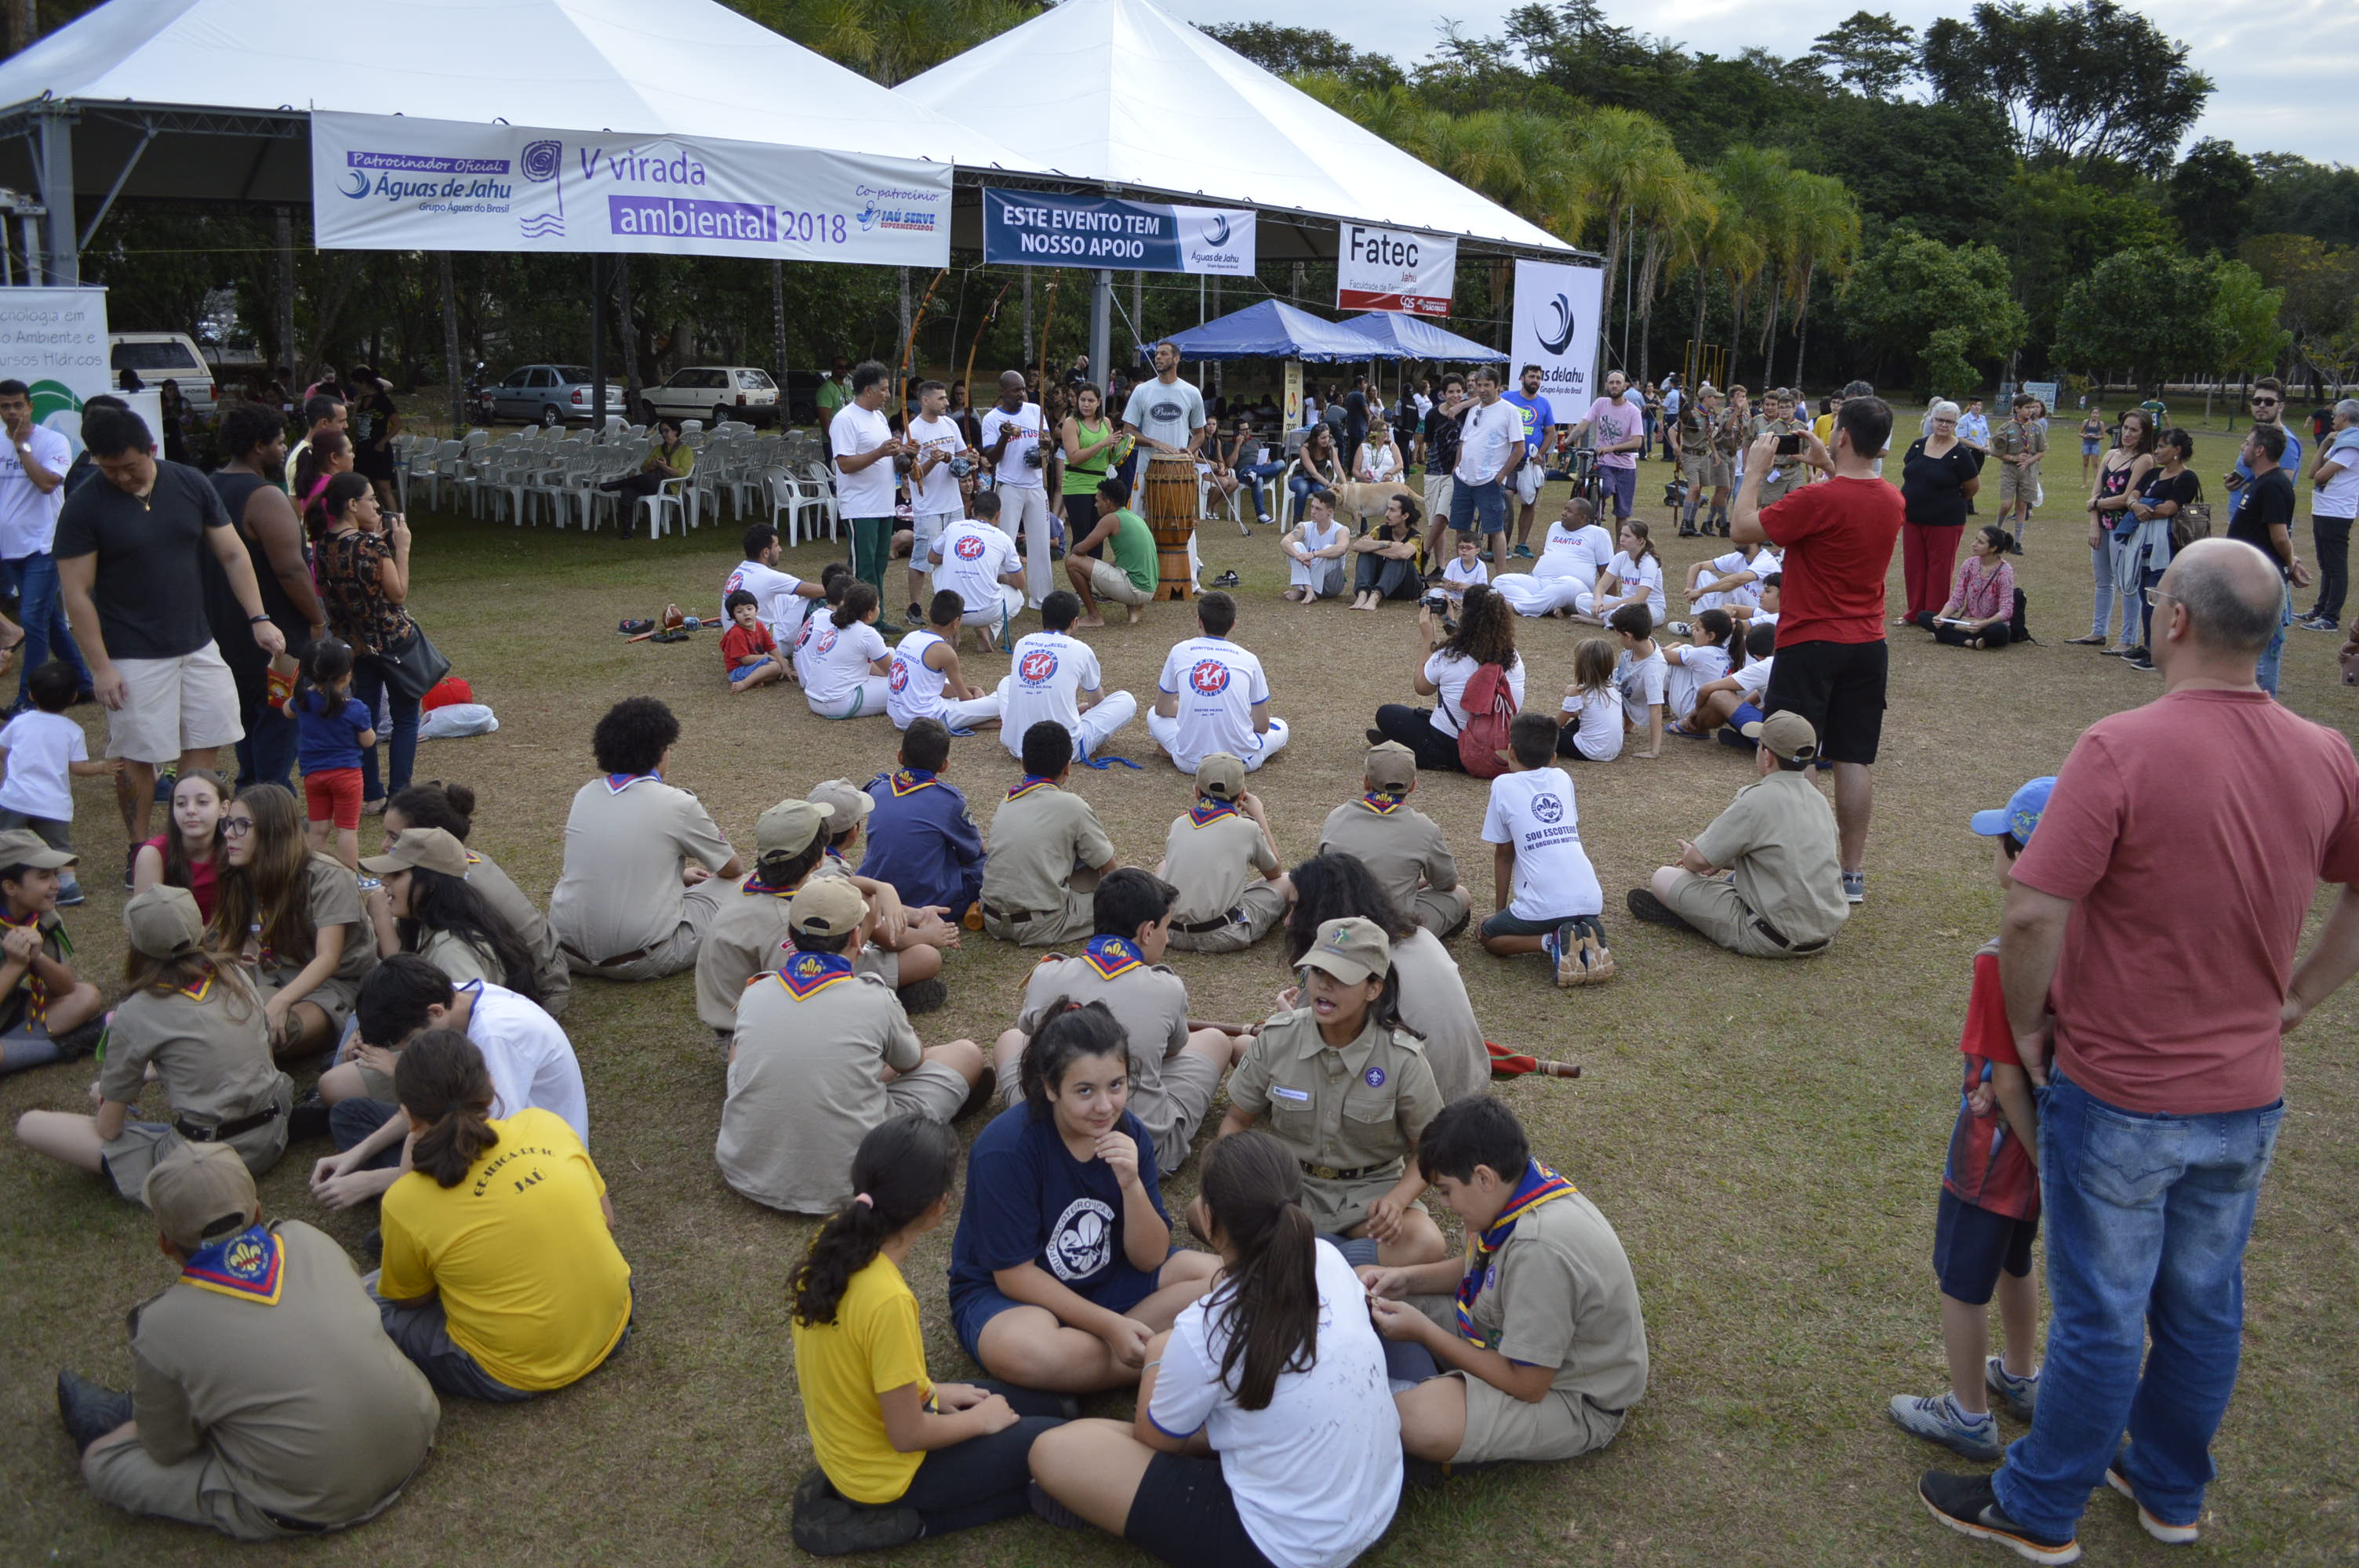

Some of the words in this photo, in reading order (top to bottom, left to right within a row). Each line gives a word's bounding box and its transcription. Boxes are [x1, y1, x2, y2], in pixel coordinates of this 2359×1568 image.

[353, 153, 451, 171] Patrocinador
[454, 159, 503, 173] Oficial:
[580, 147, 602, 180] V
[609, 149, 707, 186] virada
[374, 171, 439, 201] Águas
[437, 178, 465, 198] de
[464, 178, 511, 199] Jahu
[419, 201, 446, 214] Grupo
[446, 201, 474, 215] Águas
[474, 202, 486, 212] do
[485, 203, 511, 214] Brasil
[620, 200, 769, 240] ambiental
[781, 209, 848, 245] 2018
[881, 208, 902, 223] JAÚ
[903, 212, 936, 224] SERVE
[1003, 205, 1049, 227] ESTE
[1052, 210, 1122, 234] EVENTO
[1125, 215, 1160, 236] TEM
[880, 222, 934, 231] SUPERMERCADOS
[1021, 233, 1085, 256] NOSSO
[1089, 236, 1144, 259] APOIO
[1350, 227, 1419, 268] Fatec
[1190, 249, 1214, 263] Águas
[1213, 253, 1223, 263] de
[1223, 253, 1240, 263] Jahu
[1401, 270, 1418, 283] Jahu
[1349, 279, 1379, 291] Faculdade
[64, 311, 85, 321] em
[16, 329, 82, 344] Ambiente
[87, 332, 96, 343] e
[44, 352, 103, 367] Hídricos
[1539, 385, 1556, 395] Grupo
[1552, 535, 1583, 546] BANTUS
[1525, 830, 1543, 842] SOU
[1535, 838, 1561, 849] ORGULHO
[514, 1167, 547, 1195] JAÚ
[1048, 1243, 1067, 1277] GRUPO
